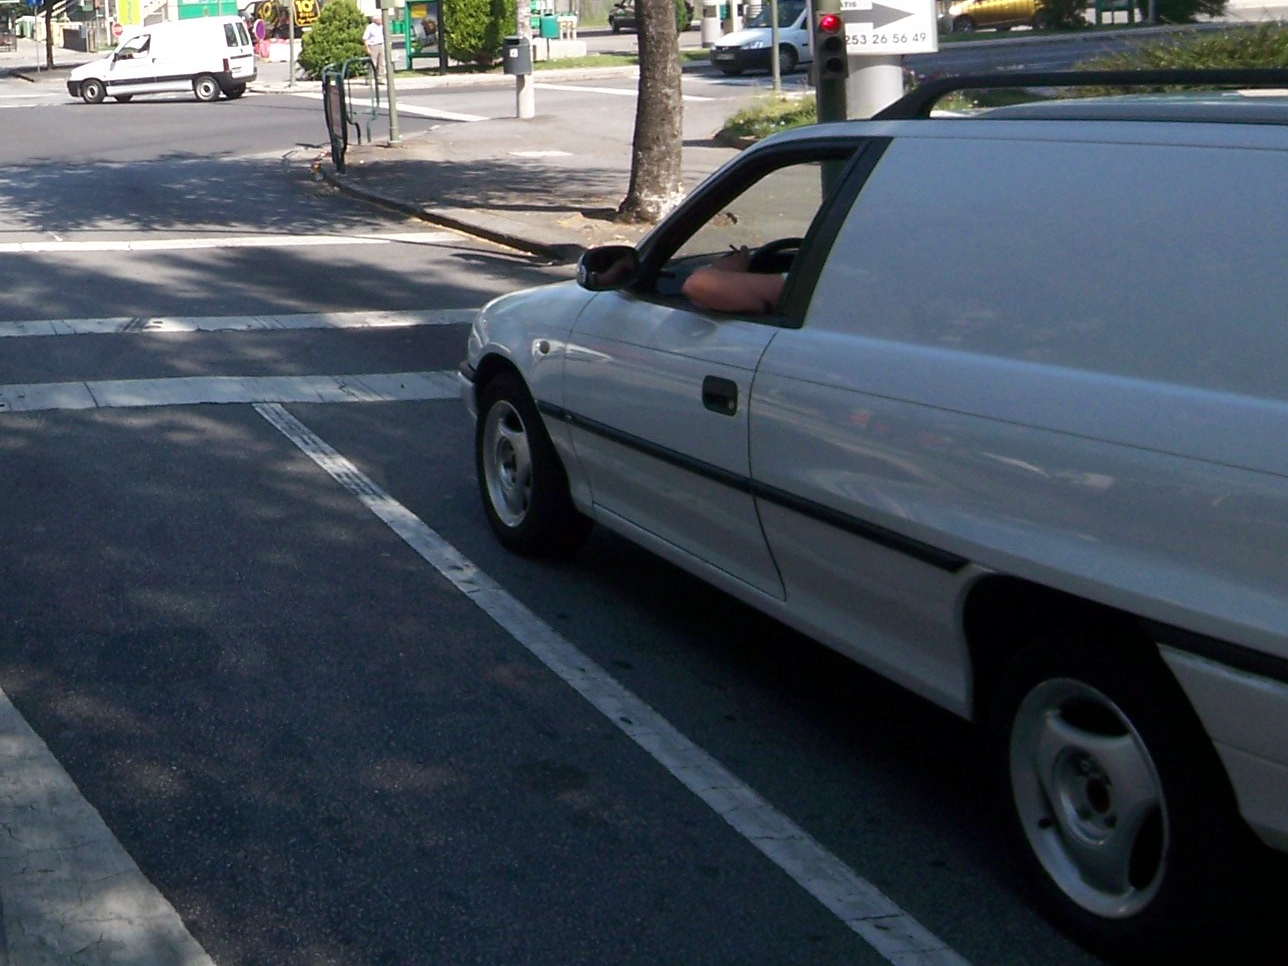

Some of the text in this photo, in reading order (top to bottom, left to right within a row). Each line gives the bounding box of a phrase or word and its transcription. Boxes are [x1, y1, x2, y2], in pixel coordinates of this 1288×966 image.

[844, 32, 927, 45] 253 26 56 49
